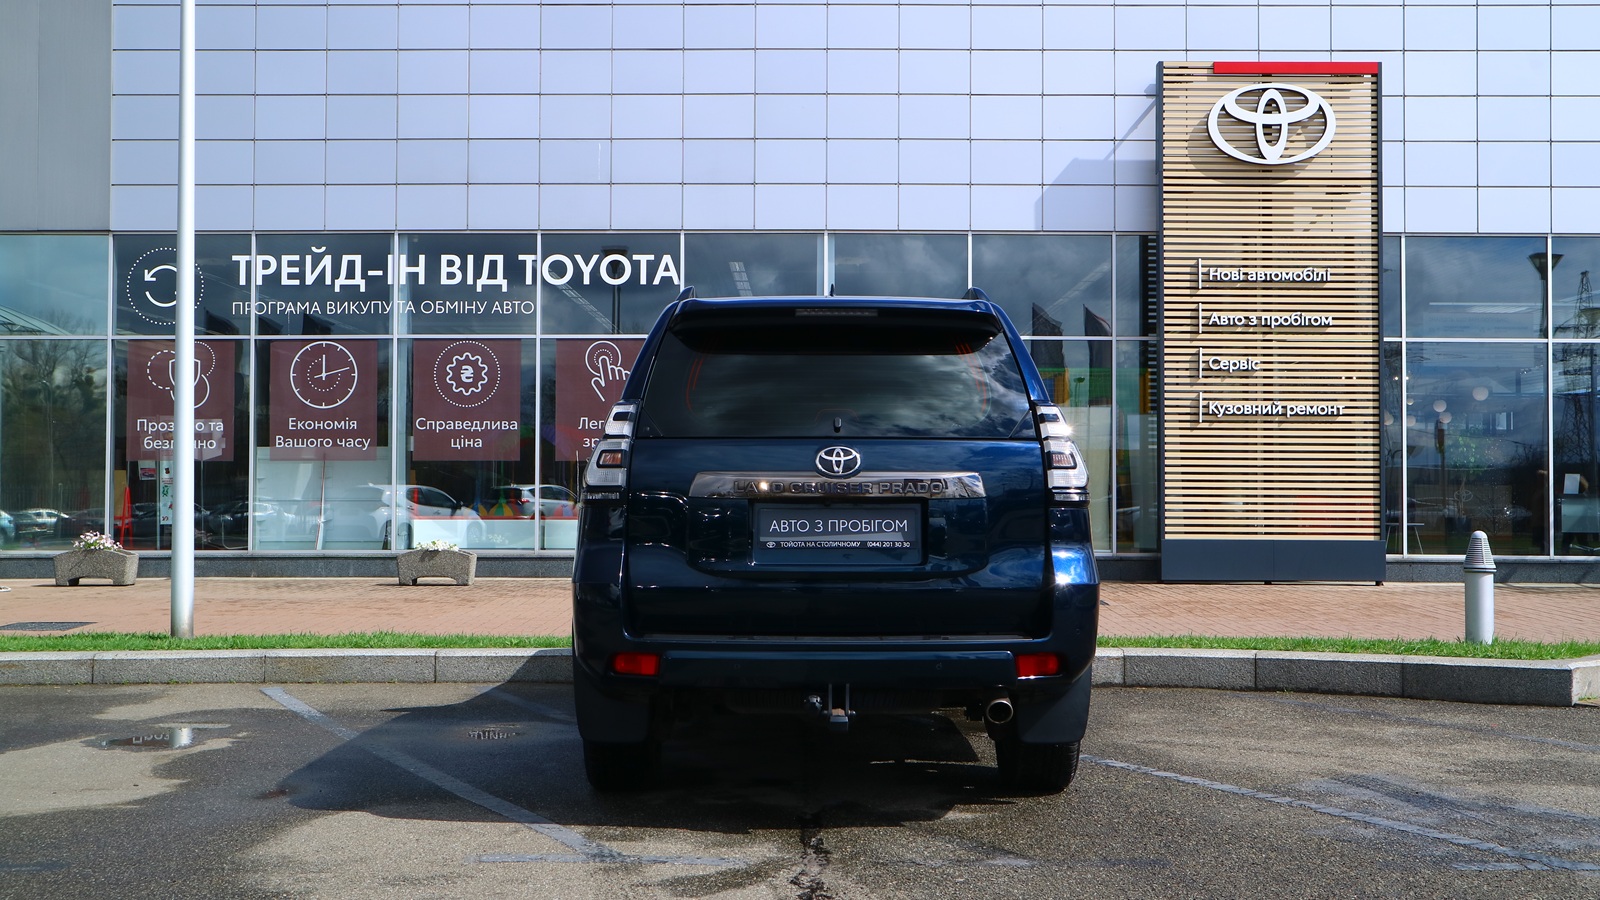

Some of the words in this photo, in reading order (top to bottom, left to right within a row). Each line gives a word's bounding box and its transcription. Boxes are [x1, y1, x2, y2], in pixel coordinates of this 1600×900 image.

[231, 246, 425, 292] ТРЕЙД-ІН
[440, 254, 508, 292] ВІД
[518, 254, 679, 285] TOYOTA
[1209, 267, 1244, 282] Нові
[1247, 267, 1331, 282] автомобілі
[232, 301, 322, 315] ПРОГРАМА
[326, 300, 393, 315] ВИКУПУ
[395, 300, 416, 314] ТА
[420, 300, 488, 315] ОБМІНУ
[491, 301, 535, 314] АВТО
[1209, 312, 1245, 326] Авто
[1248, 316, 1258, 326] з
[1261, 311, 1333, 329] пробігом
[1209, 357, 1261, 373] Сервіс
[1209, 401, 1283, 418] Кузовний
[1286, 404, 1346, 419] ремонт
[136, 418, 204, 434] Прозо
[208, 421, 224, 432] та
[288, 417, 358, 431] Економія
[415, 417, 518, 433] Справедлива
[578, 416, 605, 430] Лег
[143, 435, 217, 449] безно
[275, 435, 333, 449] Вашого
[336, 437, 370, 450] часу
[450, 435, 483, 450] ціна
[789, 481, 873, 495] CRUISER
[878, 480, 943, 495] PRADO
[769, 519, 810, 533] АВТО
[828, 519, 908, 532] ПРОБІГОМ
[780, 540, 805, 548] ТОЙОТА
